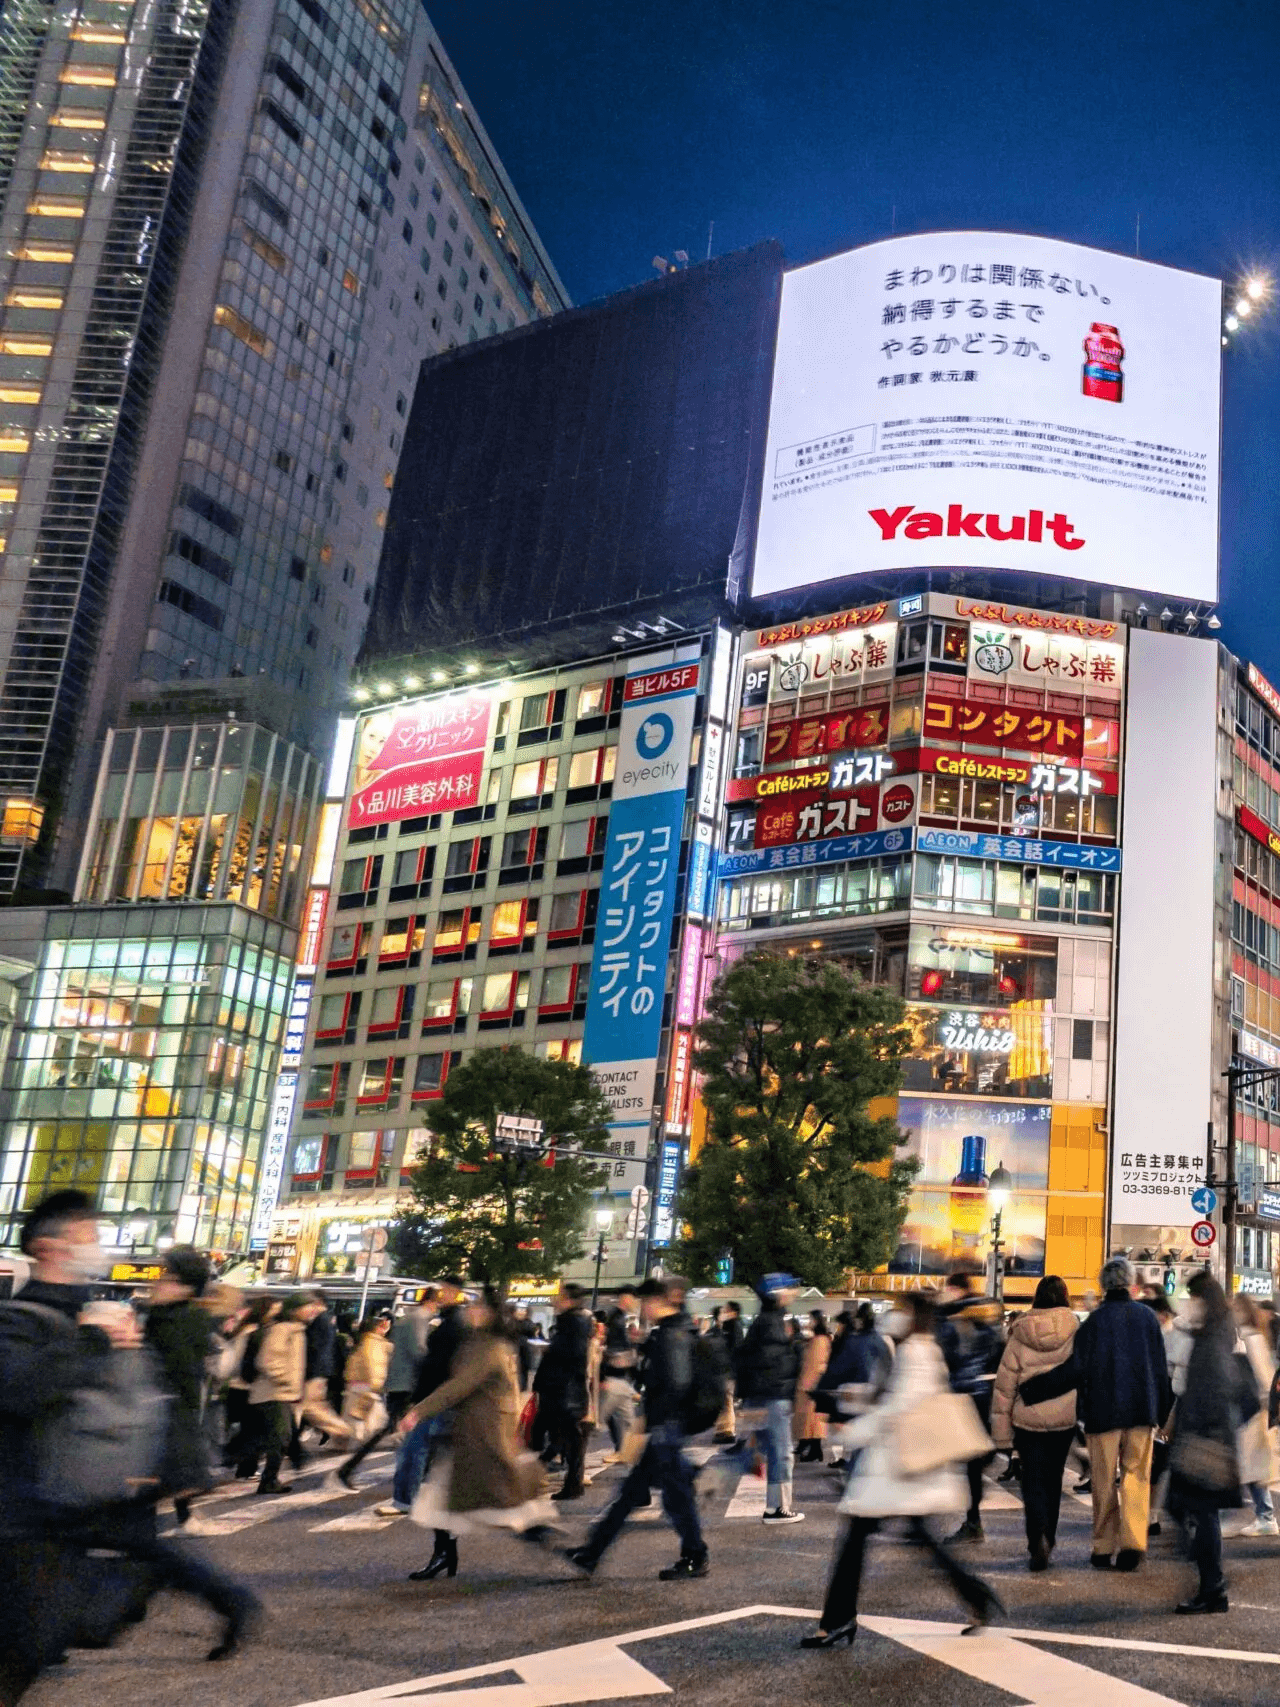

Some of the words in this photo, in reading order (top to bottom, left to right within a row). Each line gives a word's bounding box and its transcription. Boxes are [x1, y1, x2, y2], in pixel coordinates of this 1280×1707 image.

[884, 263, 1111, 305] まわりは関係ない。
[881, 297, 1045, 325] 納得するまで
[880, 331, 1051, 362] やるかどうか。
[868, 504, 1086, 551] Yakult
[757, 602, 888, 647] しゃぶしゃぶバイキング
[956, 599, 1118, 639] しゃぶしゃぶバイキング
[813, 639, 888, 679] しゃぶ葉
[1023, 644, 1116, 683] しゃぶ葉
[631, 667, 693, 698] 当ビル5F
[746, 671, 769, 690] 9F
[414, 725, 475, 753] クリニック
[926, 702, 1078, 746] コンタクト
[622, 760, 681, 786] eyecity
[830, 755, 894, 790] ガスト
[935, 755, 1028, 782] Caféレストラン
[1030, 763, 1103, 795] ガスト
[366, 773, 474, 816] 品川美容外科
[885, 800, 911, 813] ガスト
[730, 818, 757, 842] 7F
[763, 810, 795, 830] Café
[796, 798, 871, 840] ガスト
[724, 854, 758, 871] AEON
[770, 837, 878, 868] 英会話イーオン
[924, 831, 971, 849] AEON
[982, 836, 1116, 867] 英会話イーオン
[598, 829, 646, 1018] アイシティ
[631, 826, 671, 1016] コンタクトの
[942, 1026, 1017, 1053] Ushi8
[595, 1070, 639, 1084] CONTACT
[603, 1085, 627, 1096] LENS
[1121, 1153, 1203, 1170] 広告主募集中
[1123, 1171, 1202, 1184] ツツミプロジェクト
[1122, 1184, 1199, 1196] 03-3369-815
